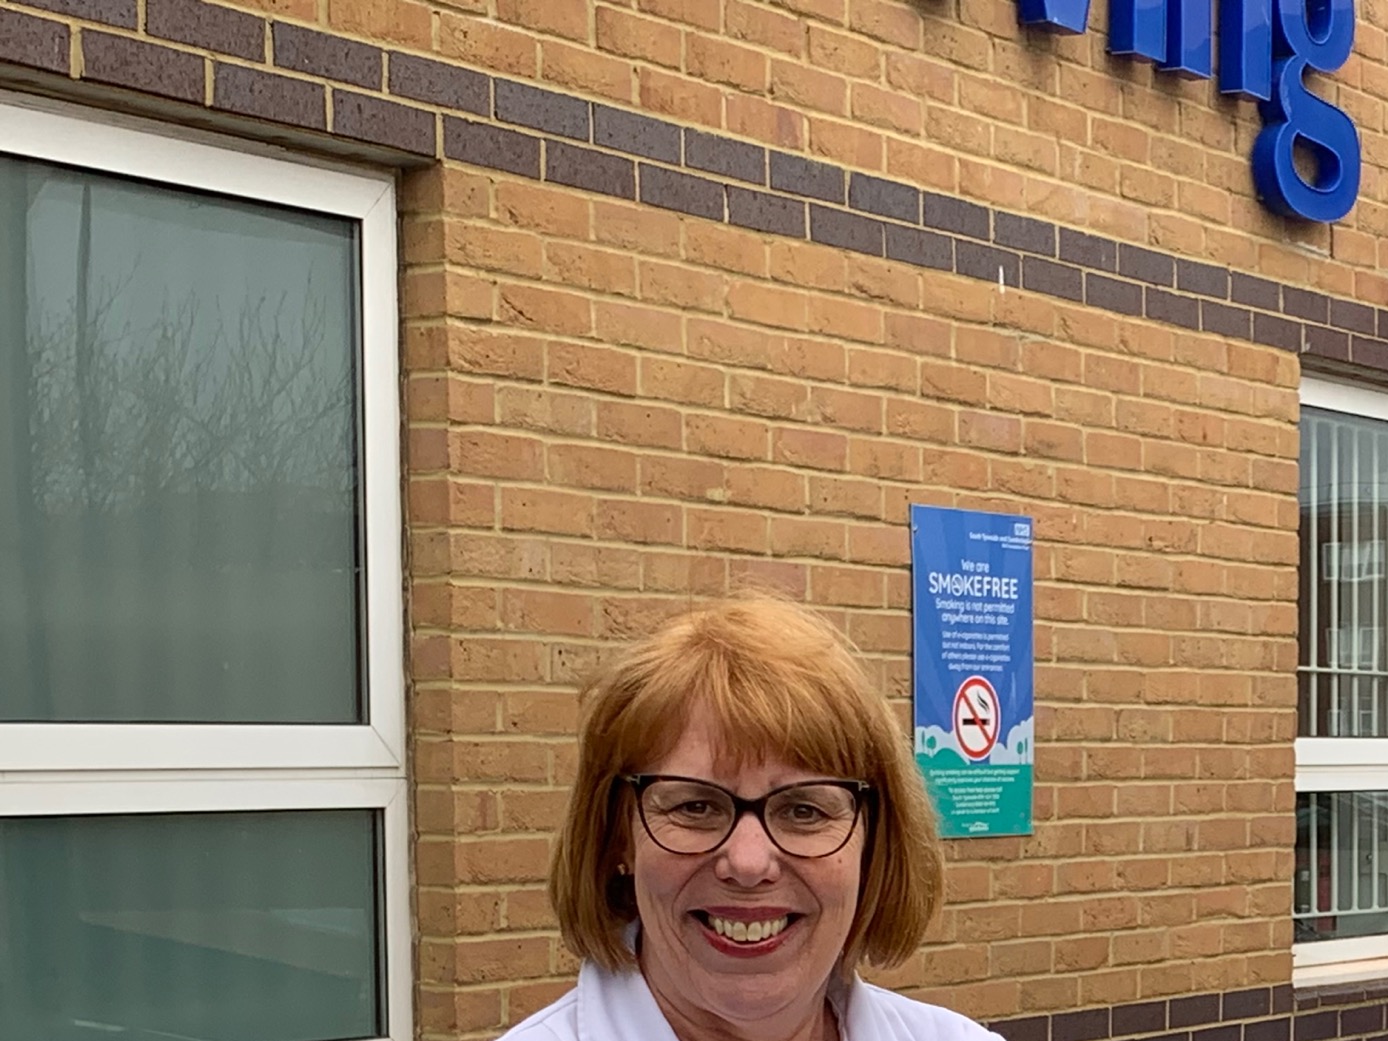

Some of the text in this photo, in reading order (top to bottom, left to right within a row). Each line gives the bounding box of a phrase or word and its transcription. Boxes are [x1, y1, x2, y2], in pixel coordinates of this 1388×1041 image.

[961, 559, 990, 574] We are
[928, 571, 1019, 600] SMOKEFREE
[935, 597, 1015, 614] Smoking is not permitted
[941, 613, 974, 625] anywhere
[975, 616, 984, 624] on
[984, 614, 996, 625] this
